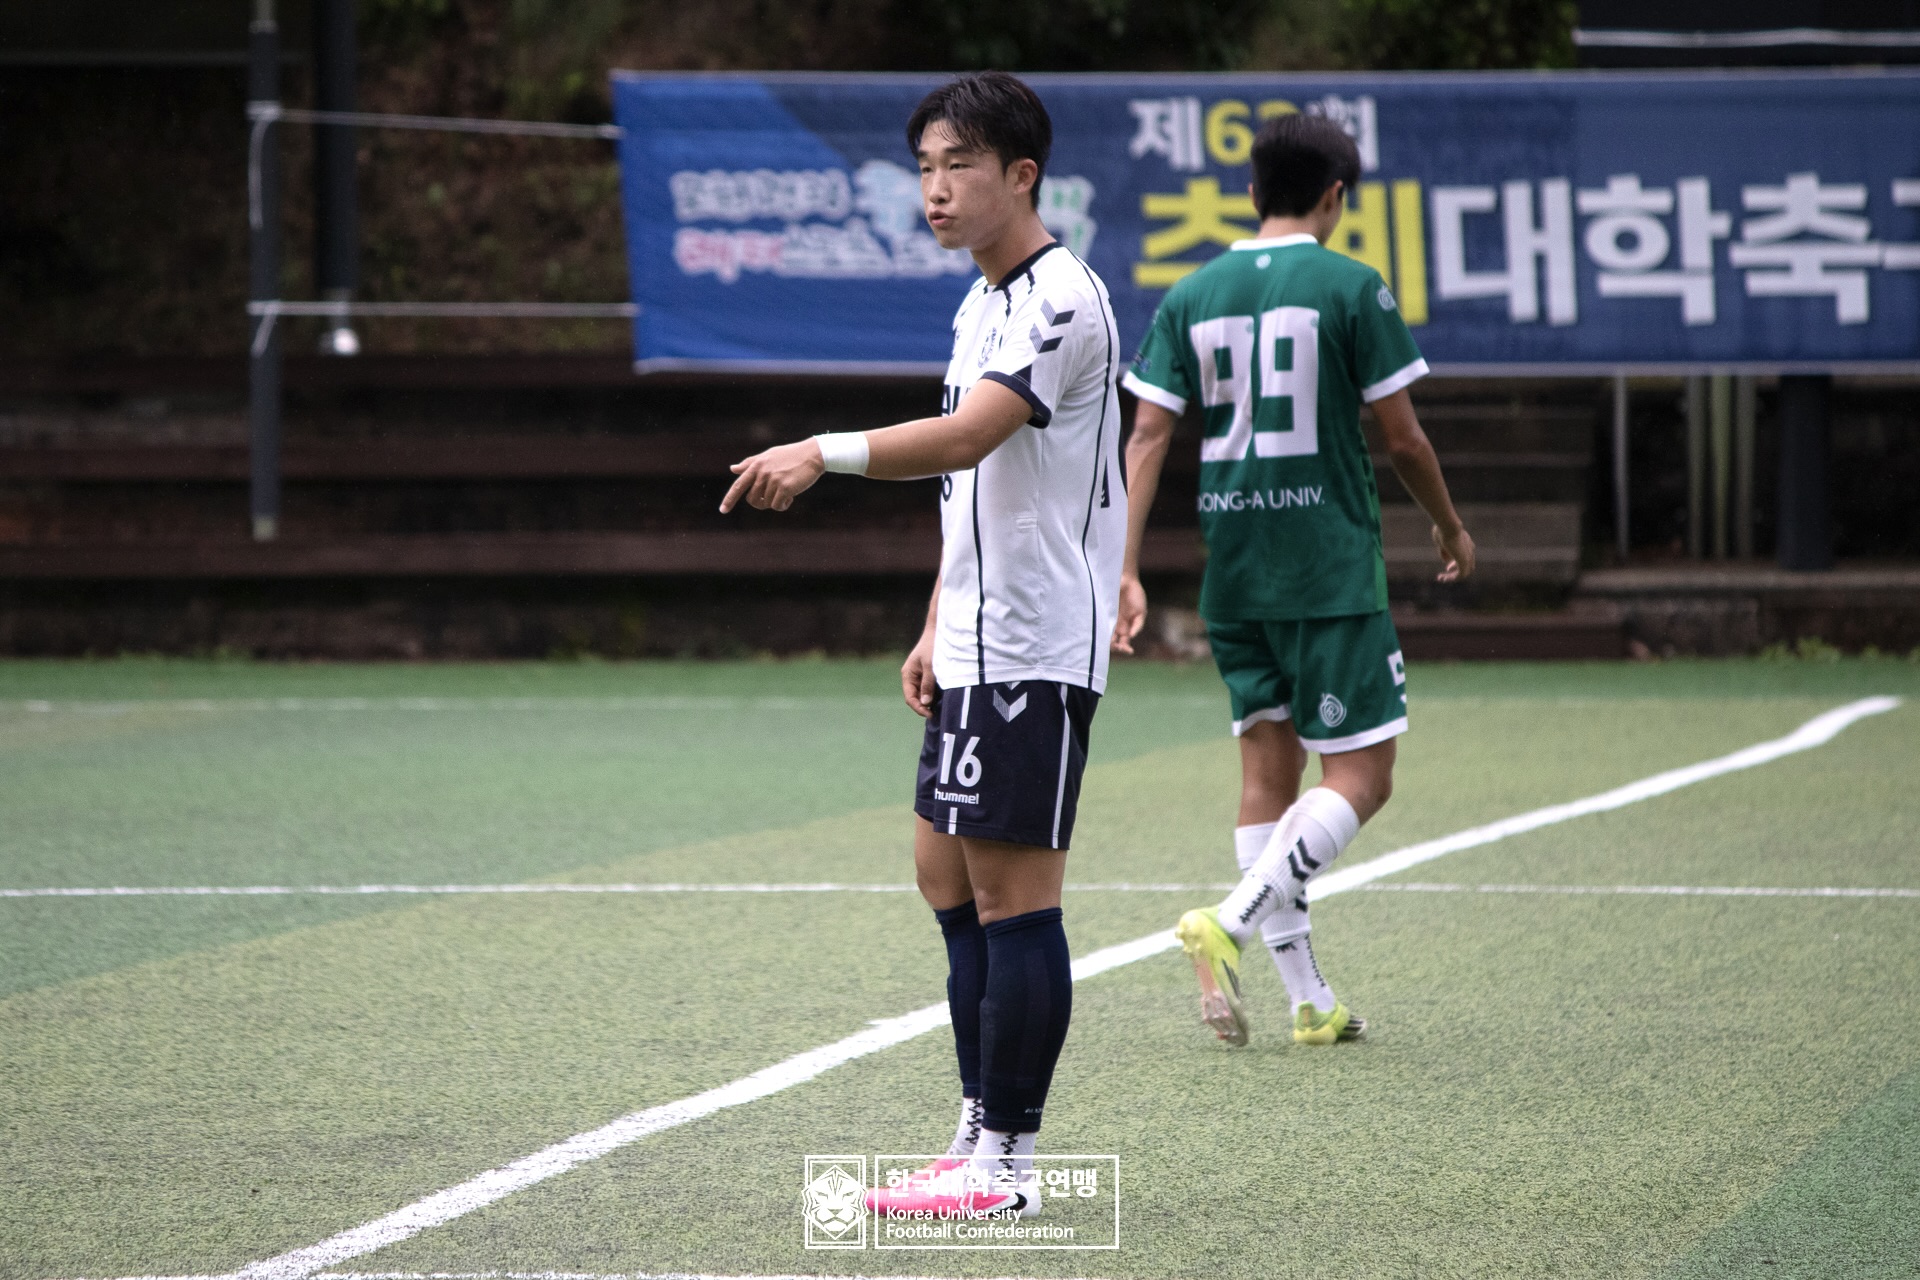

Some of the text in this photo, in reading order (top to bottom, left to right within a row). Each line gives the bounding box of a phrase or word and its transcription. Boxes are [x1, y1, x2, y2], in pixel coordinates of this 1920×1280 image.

[1132, 174, 1920, 326] 추계대학축
[1190, 307, 1319, 462] 99
[1268, 486, 1325, 508] UNIV.
[940, 733, 982, 787] 16
[935, 788, 979, 805] hummel
